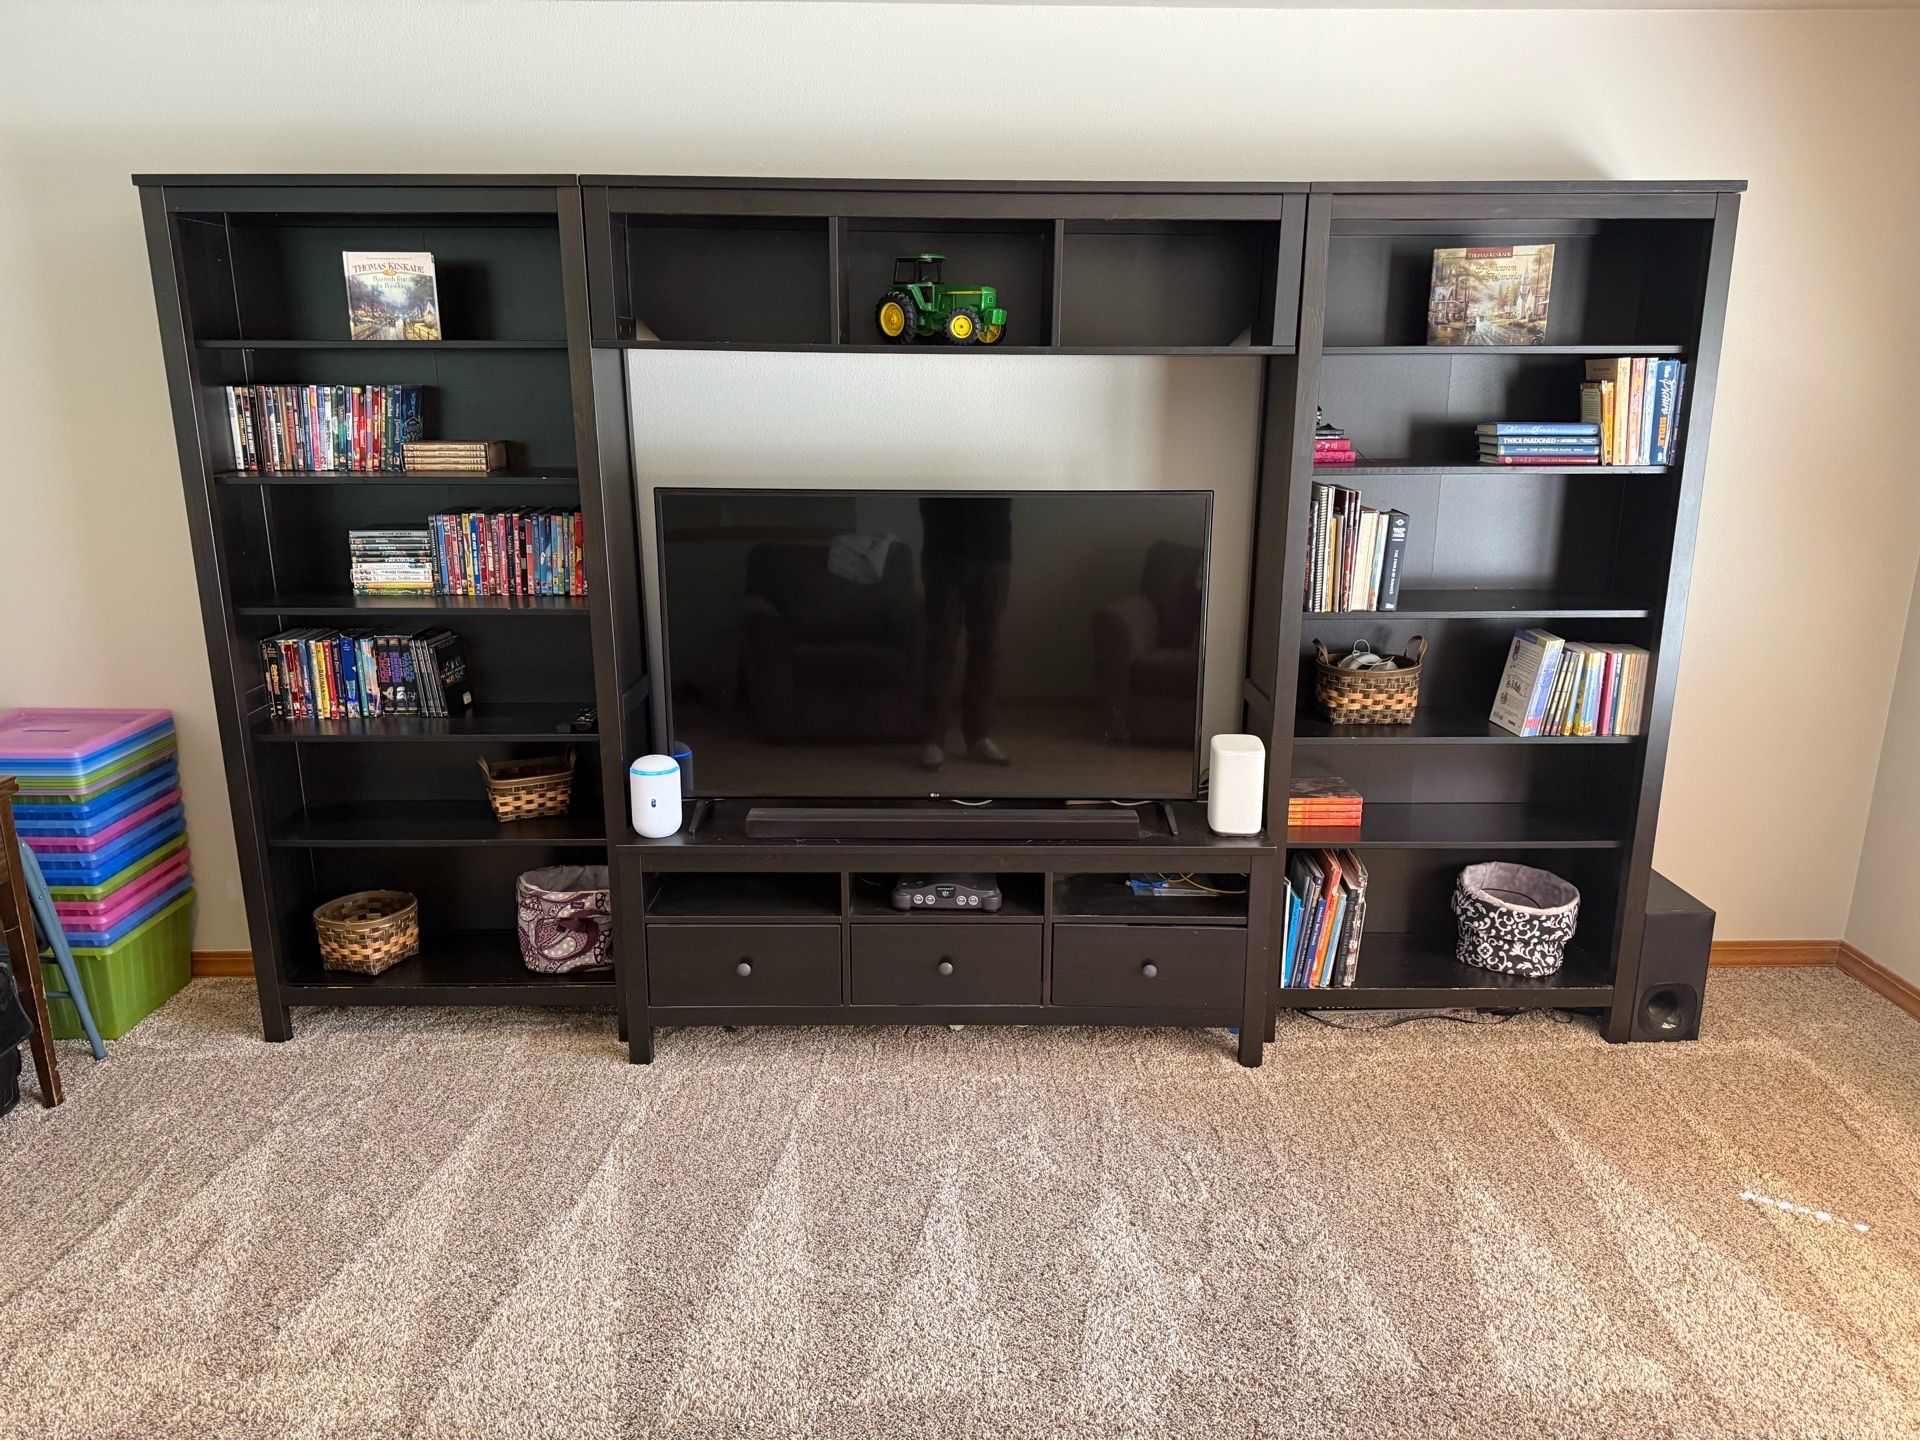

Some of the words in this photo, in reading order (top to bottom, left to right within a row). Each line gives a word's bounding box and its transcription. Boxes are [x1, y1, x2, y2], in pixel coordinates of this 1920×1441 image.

[352, 262, 386, 273] THOMAS
[388, 262, 425, 273] KINKADE
[1664, 365, 1672, 378] the
[1659, 379, 1674, 415] Picture
[1657, 416, 1668, 447] BIBLE
